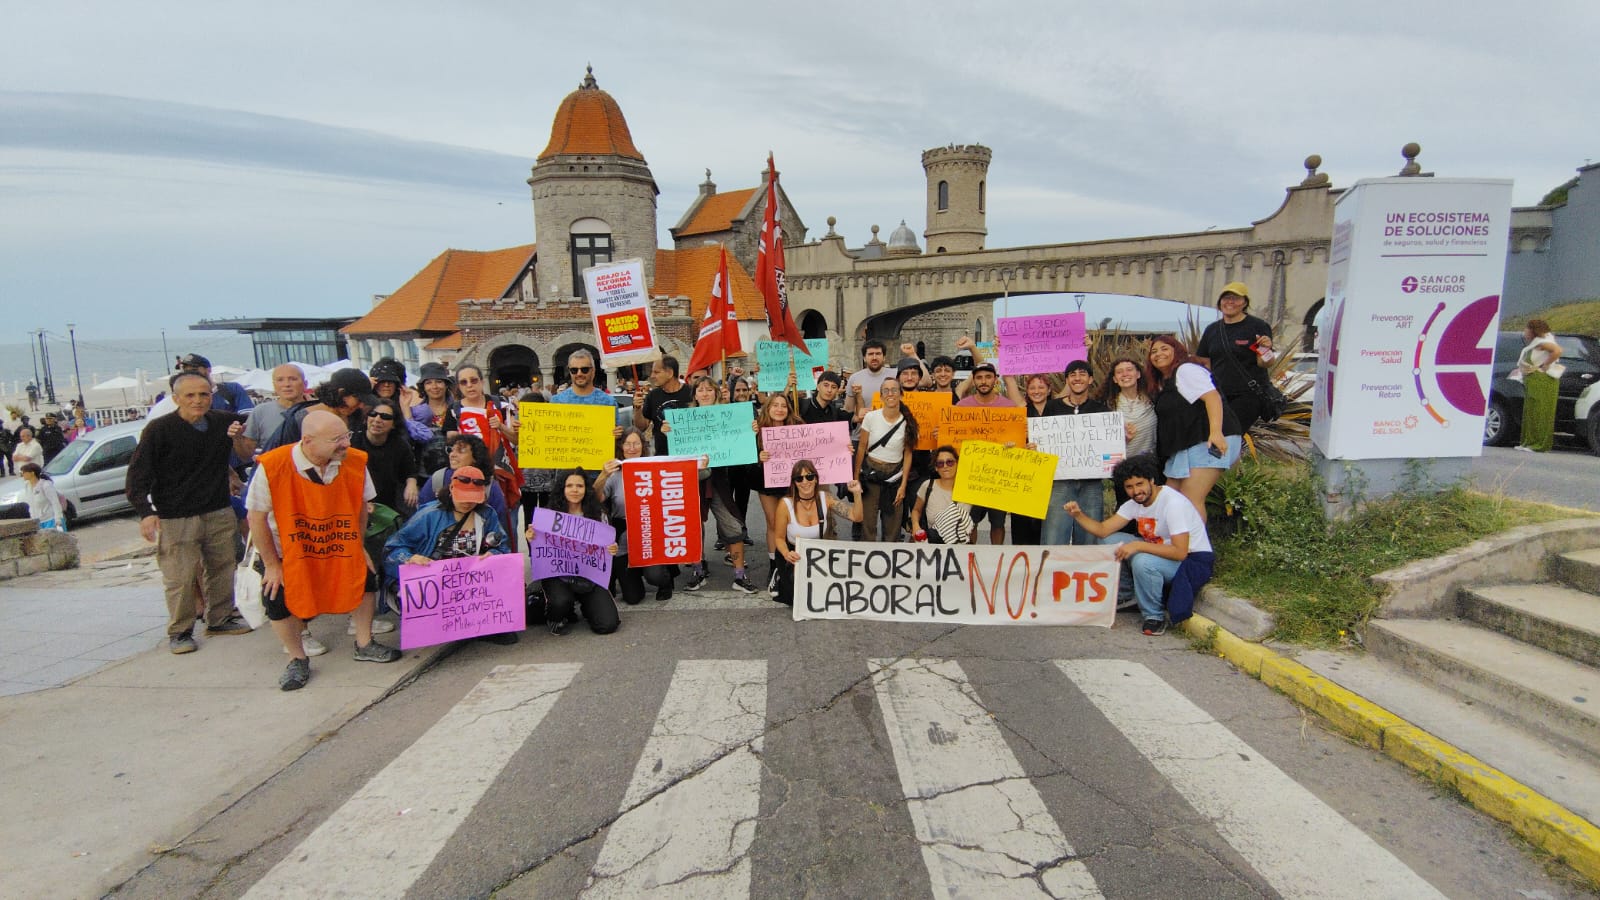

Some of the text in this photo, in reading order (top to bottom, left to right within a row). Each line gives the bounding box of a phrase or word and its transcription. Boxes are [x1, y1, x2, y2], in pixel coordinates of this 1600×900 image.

[1386, 212, 1490, 223] UN ECOSISTEMA
[1384, 225, 1489, 236] DE SOLUCIONES
[1394, 240, 1424, 248] seguros,
[596, 272, 620, 281] ABAJO
[597, 276, 632, 286] REFORMA
[1421, 275, 1466, 283] SANCOR
[598, 281, 632, 292] LABORAL
[1419, 285, 1465, 293] SEGUROS
[605, 314, 639, 327] PARTIDO
[608, 322, 639, 333] OBRERO
[1033, 415, 1075, 431] ABAJO
[1081, 415, 1096, 428] EL
[766, 429, 780, 441] EL
[780, 427, 814, 440] SILENCIO
[1047, 431, 1075, 444] MILEI
[1089, 429, 1102, 441] EL
[1105, 428, 1122, 441] FMI
[634, 471, 653, 497] PTS
[660, 470, 687, 558] JUBILADES
[336, 520, 351, 528] DE
[640, 504, 653, 560] INDEPENDIENTES
[536, 547, 571, 560] JUSTICIA
[442, 561, 462, 572] A LA
[442, 570, 494, 590] REFORMA
[806, 547, 1050, 620] REFORMA NO!
[405, 580, 439, 613] NO
[442, 587, 493, 605] LABORAL
[806, 571, 1109, 617] LABORAL PTS
[442, 599, 505, 619] ESCLAVISTA
[492, 610, 514, 624] FMI
